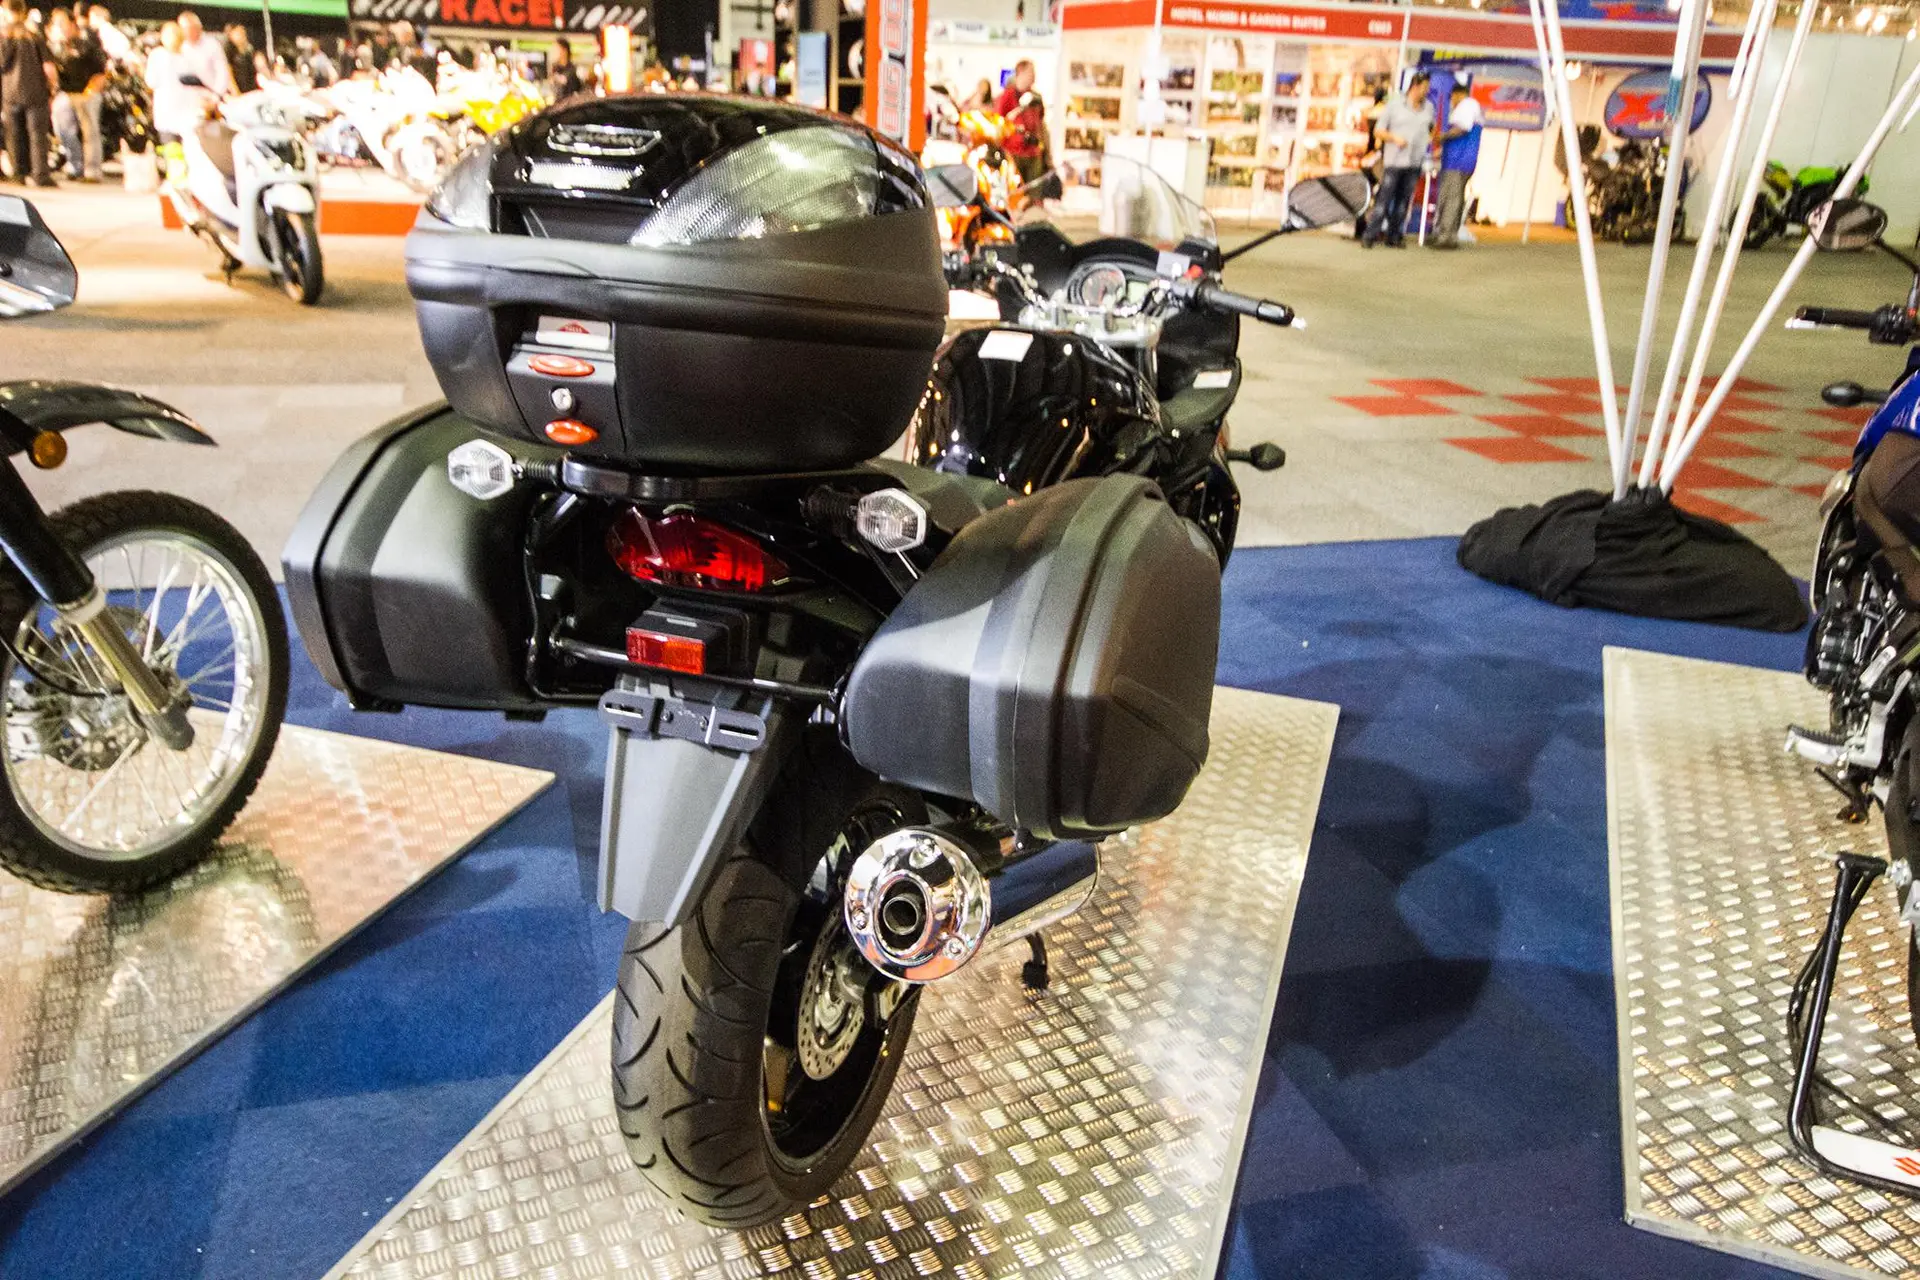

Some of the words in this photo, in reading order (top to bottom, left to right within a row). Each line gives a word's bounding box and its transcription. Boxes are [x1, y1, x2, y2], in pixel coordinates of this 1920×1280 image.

[441, 0, 564, 29] RACE!
[1170, 6, 1204, 23] HOTEL
[1249, 12, 1291, 29] GARDEN
